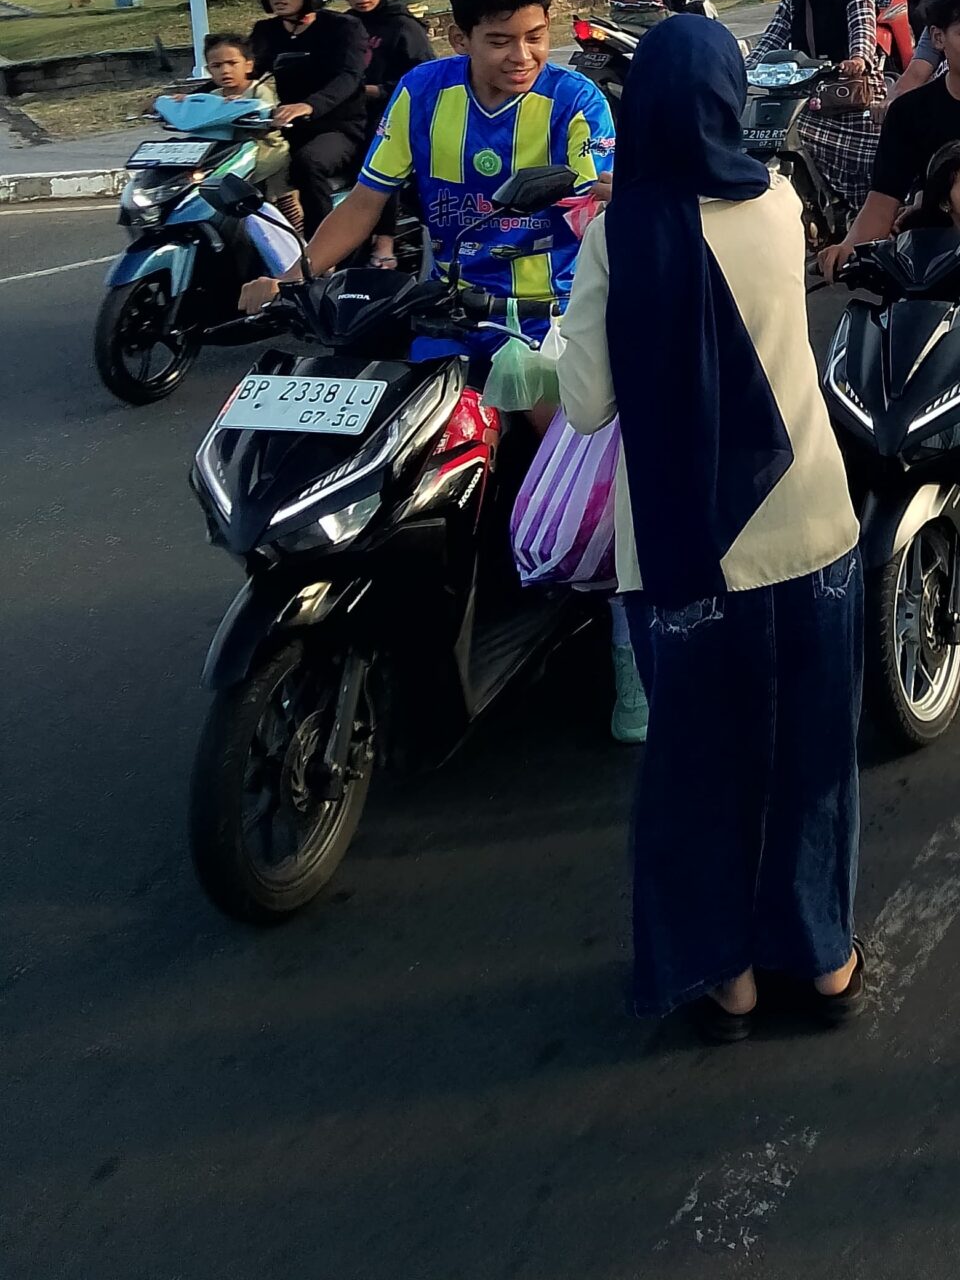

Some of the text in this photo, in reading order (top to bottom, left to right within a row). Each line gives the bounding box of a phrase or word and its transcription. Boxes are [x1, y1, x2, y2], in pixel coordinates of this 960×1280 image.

[749, 130, 771, 139] 2162
[237, 380, 379, 405] BP 2338 LJ
[458, 467, 484, 509] HONDA
